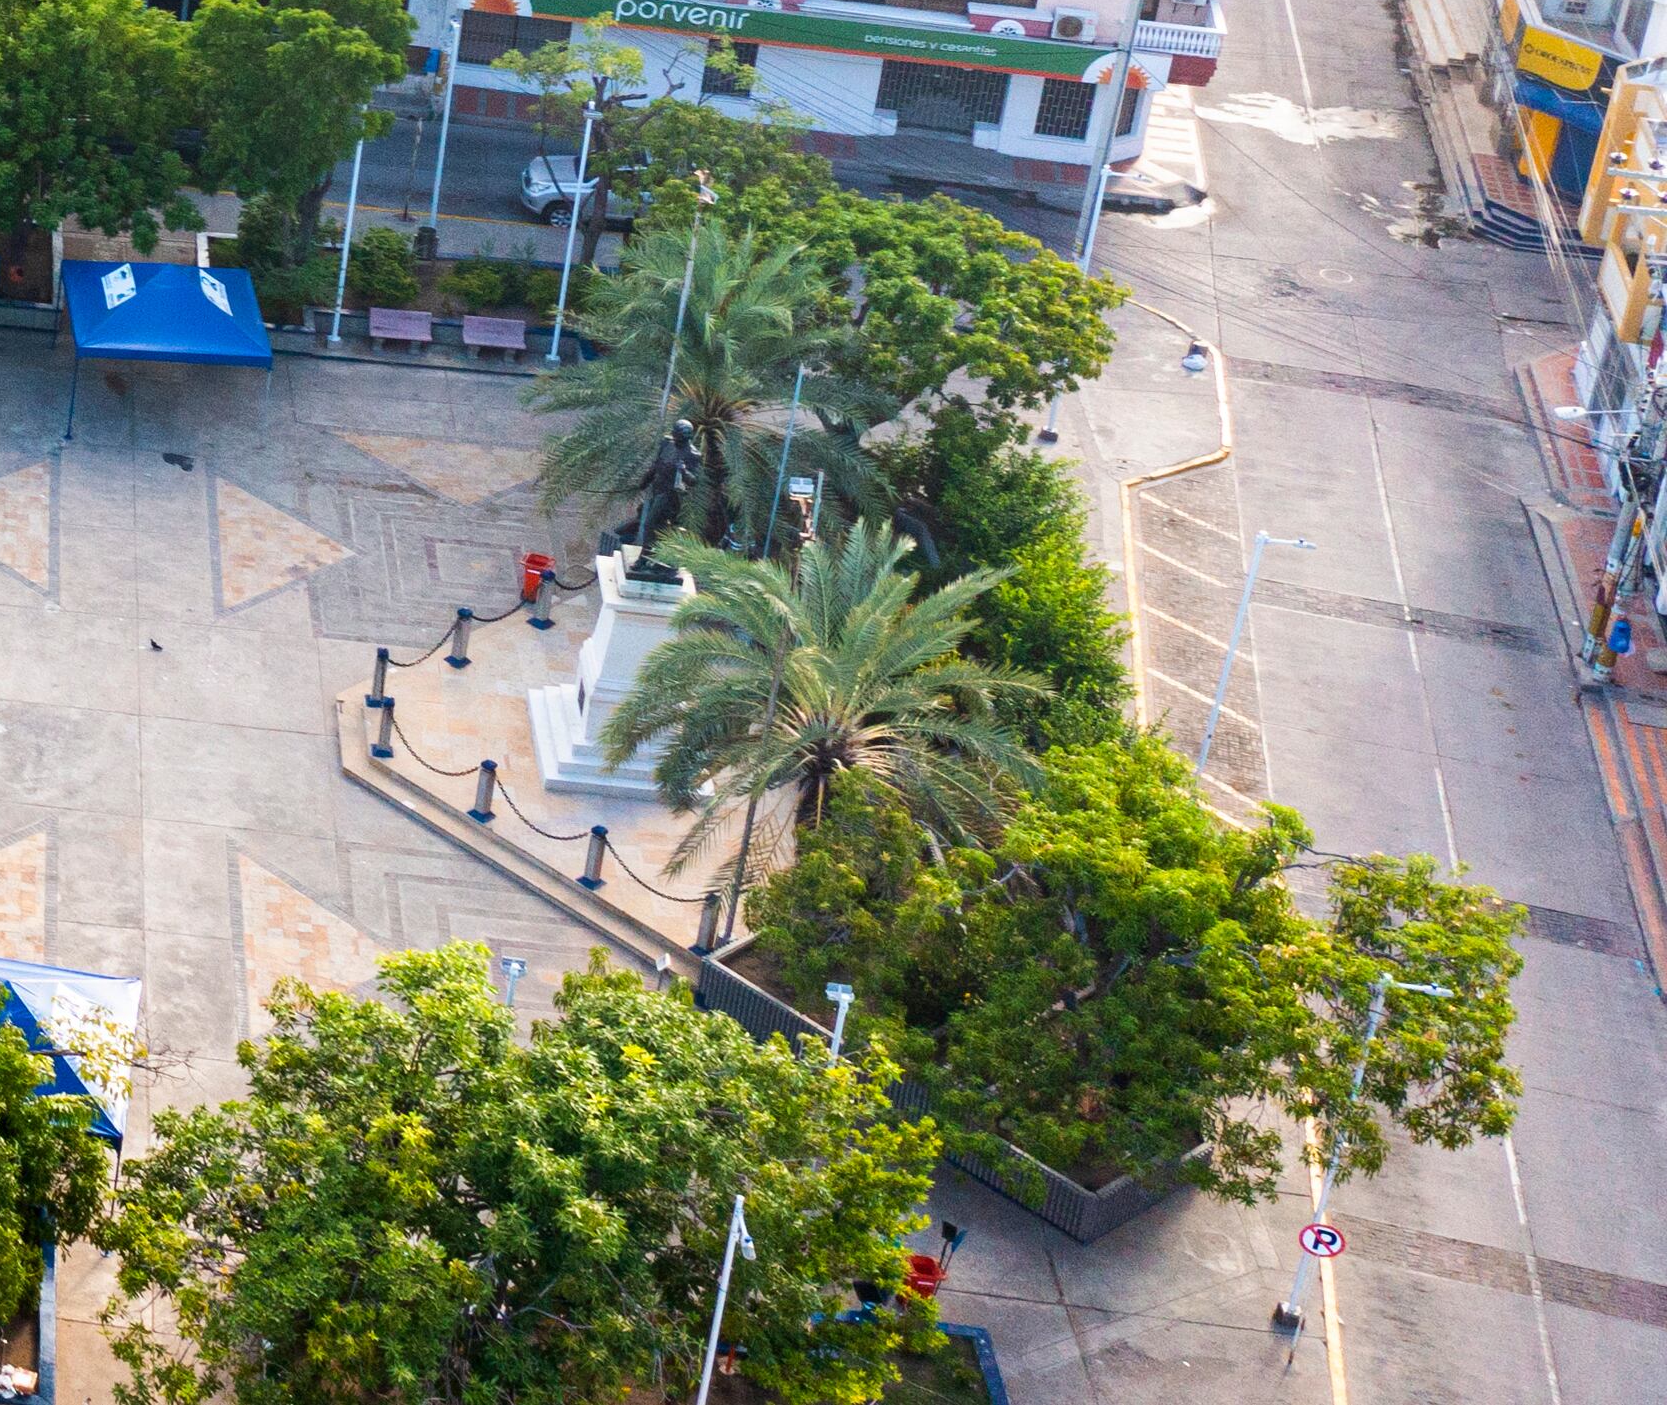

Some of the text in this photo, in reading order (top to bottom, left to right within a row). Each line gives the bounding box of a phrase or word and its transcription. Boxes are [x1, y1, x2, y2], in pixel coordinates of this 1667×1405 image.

[615, 0, 751, 29] porvenir
[865, 34, 926, 50] pensiones
[1312, 1229, 1337, 1250] P
